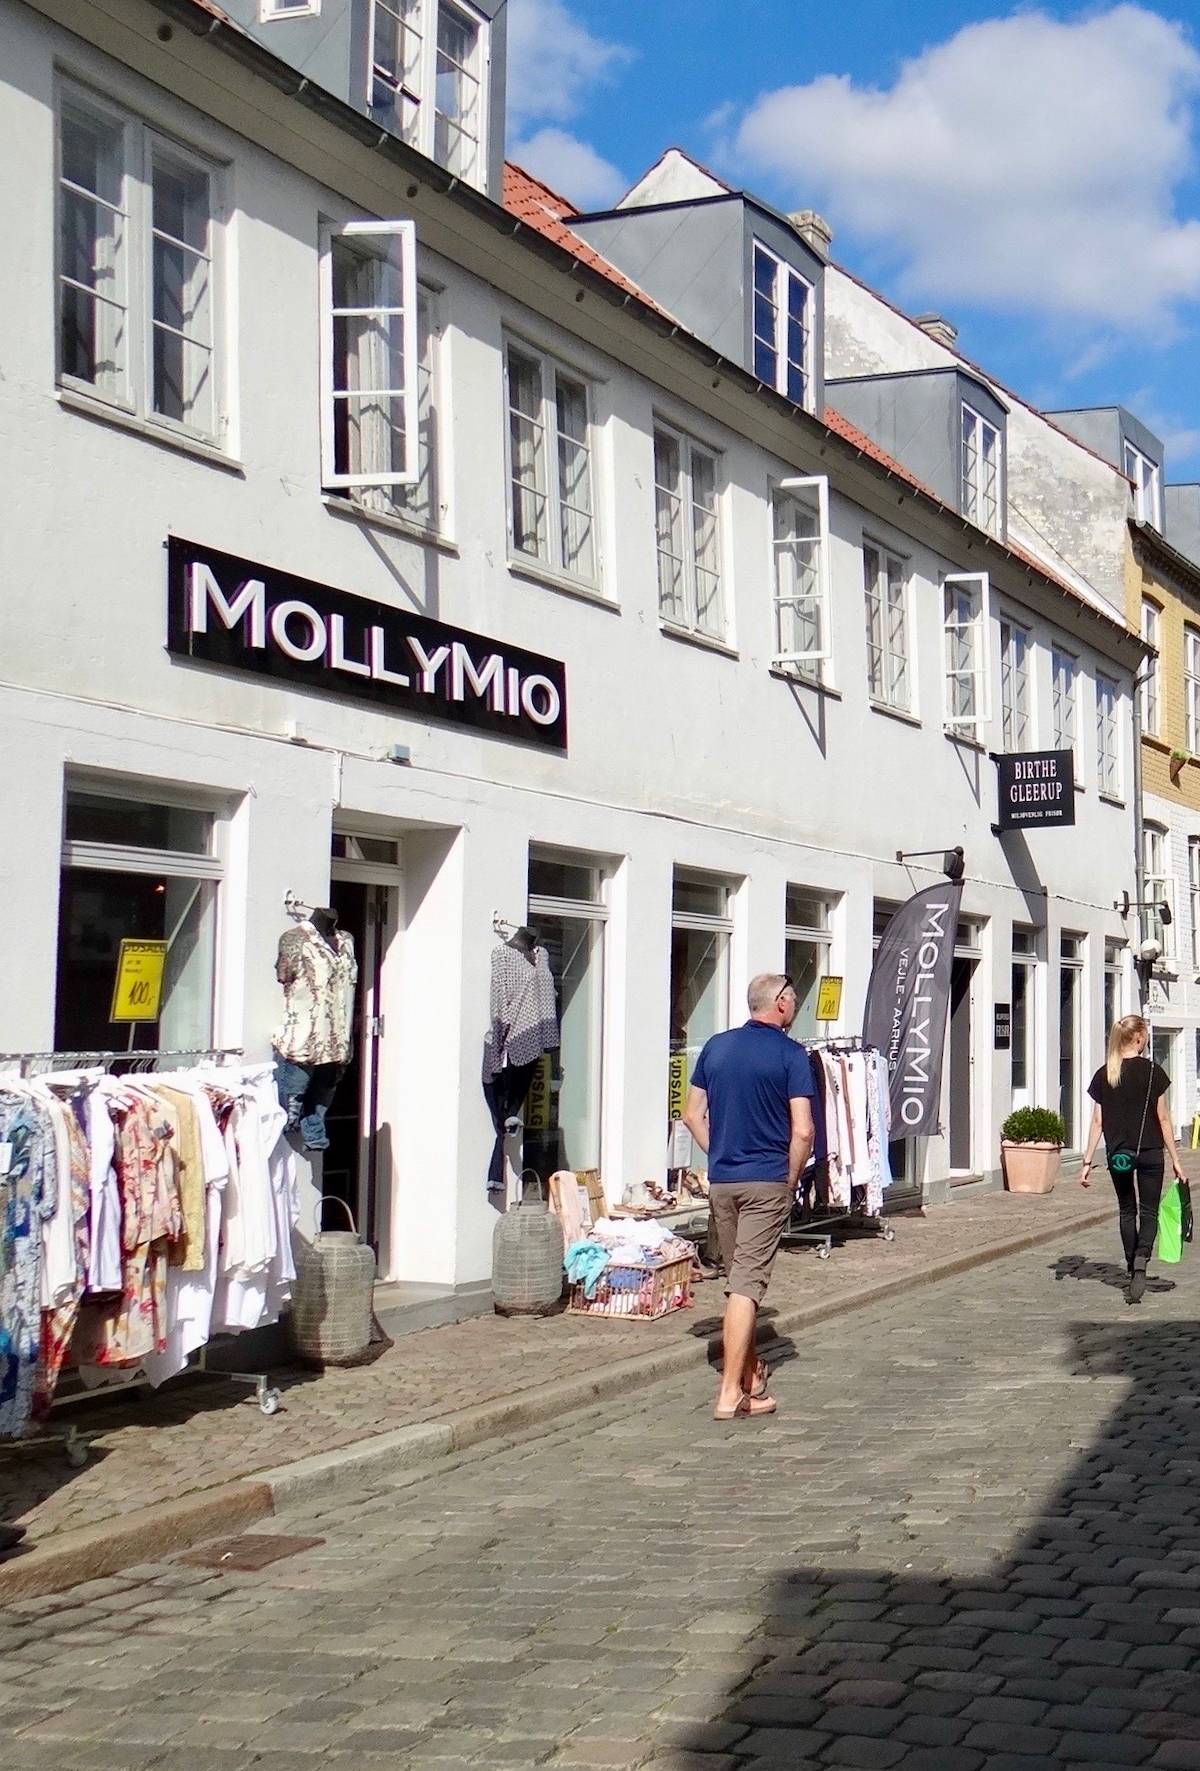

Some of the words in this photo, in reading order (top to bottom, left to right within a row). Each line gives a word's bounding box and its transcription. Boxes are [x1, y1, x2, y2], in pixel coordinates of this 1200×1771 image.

[188, 561, 560, 726] MOLLYMIO
[1010, 782, 1063, 803] GLEERUP
[1014, 759, 1057, 779] BIRTHE
[895, 947, 910, 994] VEJLE
[889, 1007, 903, 1071] AARHUS
[901, 903, 949, 1125] MOLLYMIO
